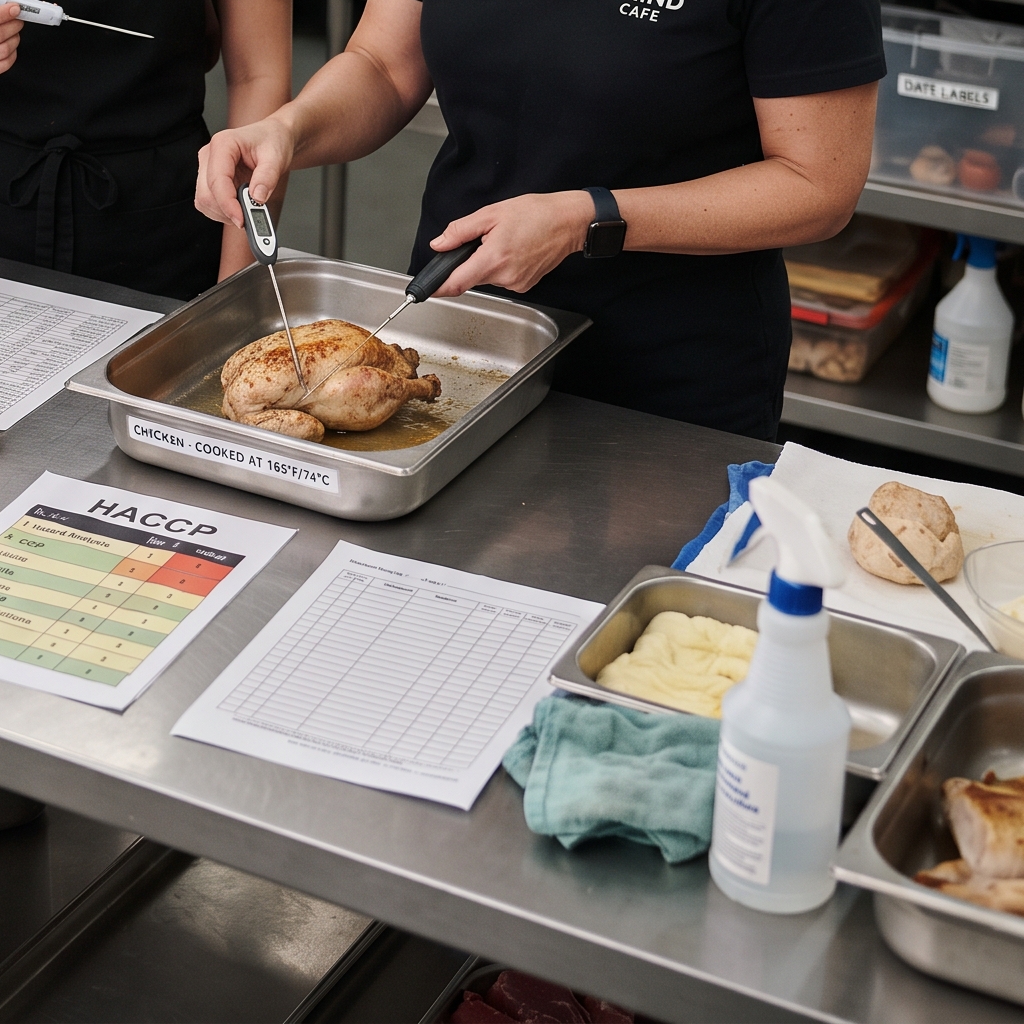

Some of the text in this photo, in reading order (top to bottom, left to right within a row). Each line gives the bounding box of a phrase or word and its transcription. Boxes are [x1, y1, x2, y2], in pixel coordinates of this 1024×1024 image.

[619, 2, 660, 22] CAFE
[904, 79, 989, 104] DATE LABELS
[133, 424, 184, 448] CHICKEN
[195, 442, 245, 463] COOKED
[248, 455, 263, 468] AT
[87, 499, 219, 537] HACCP
